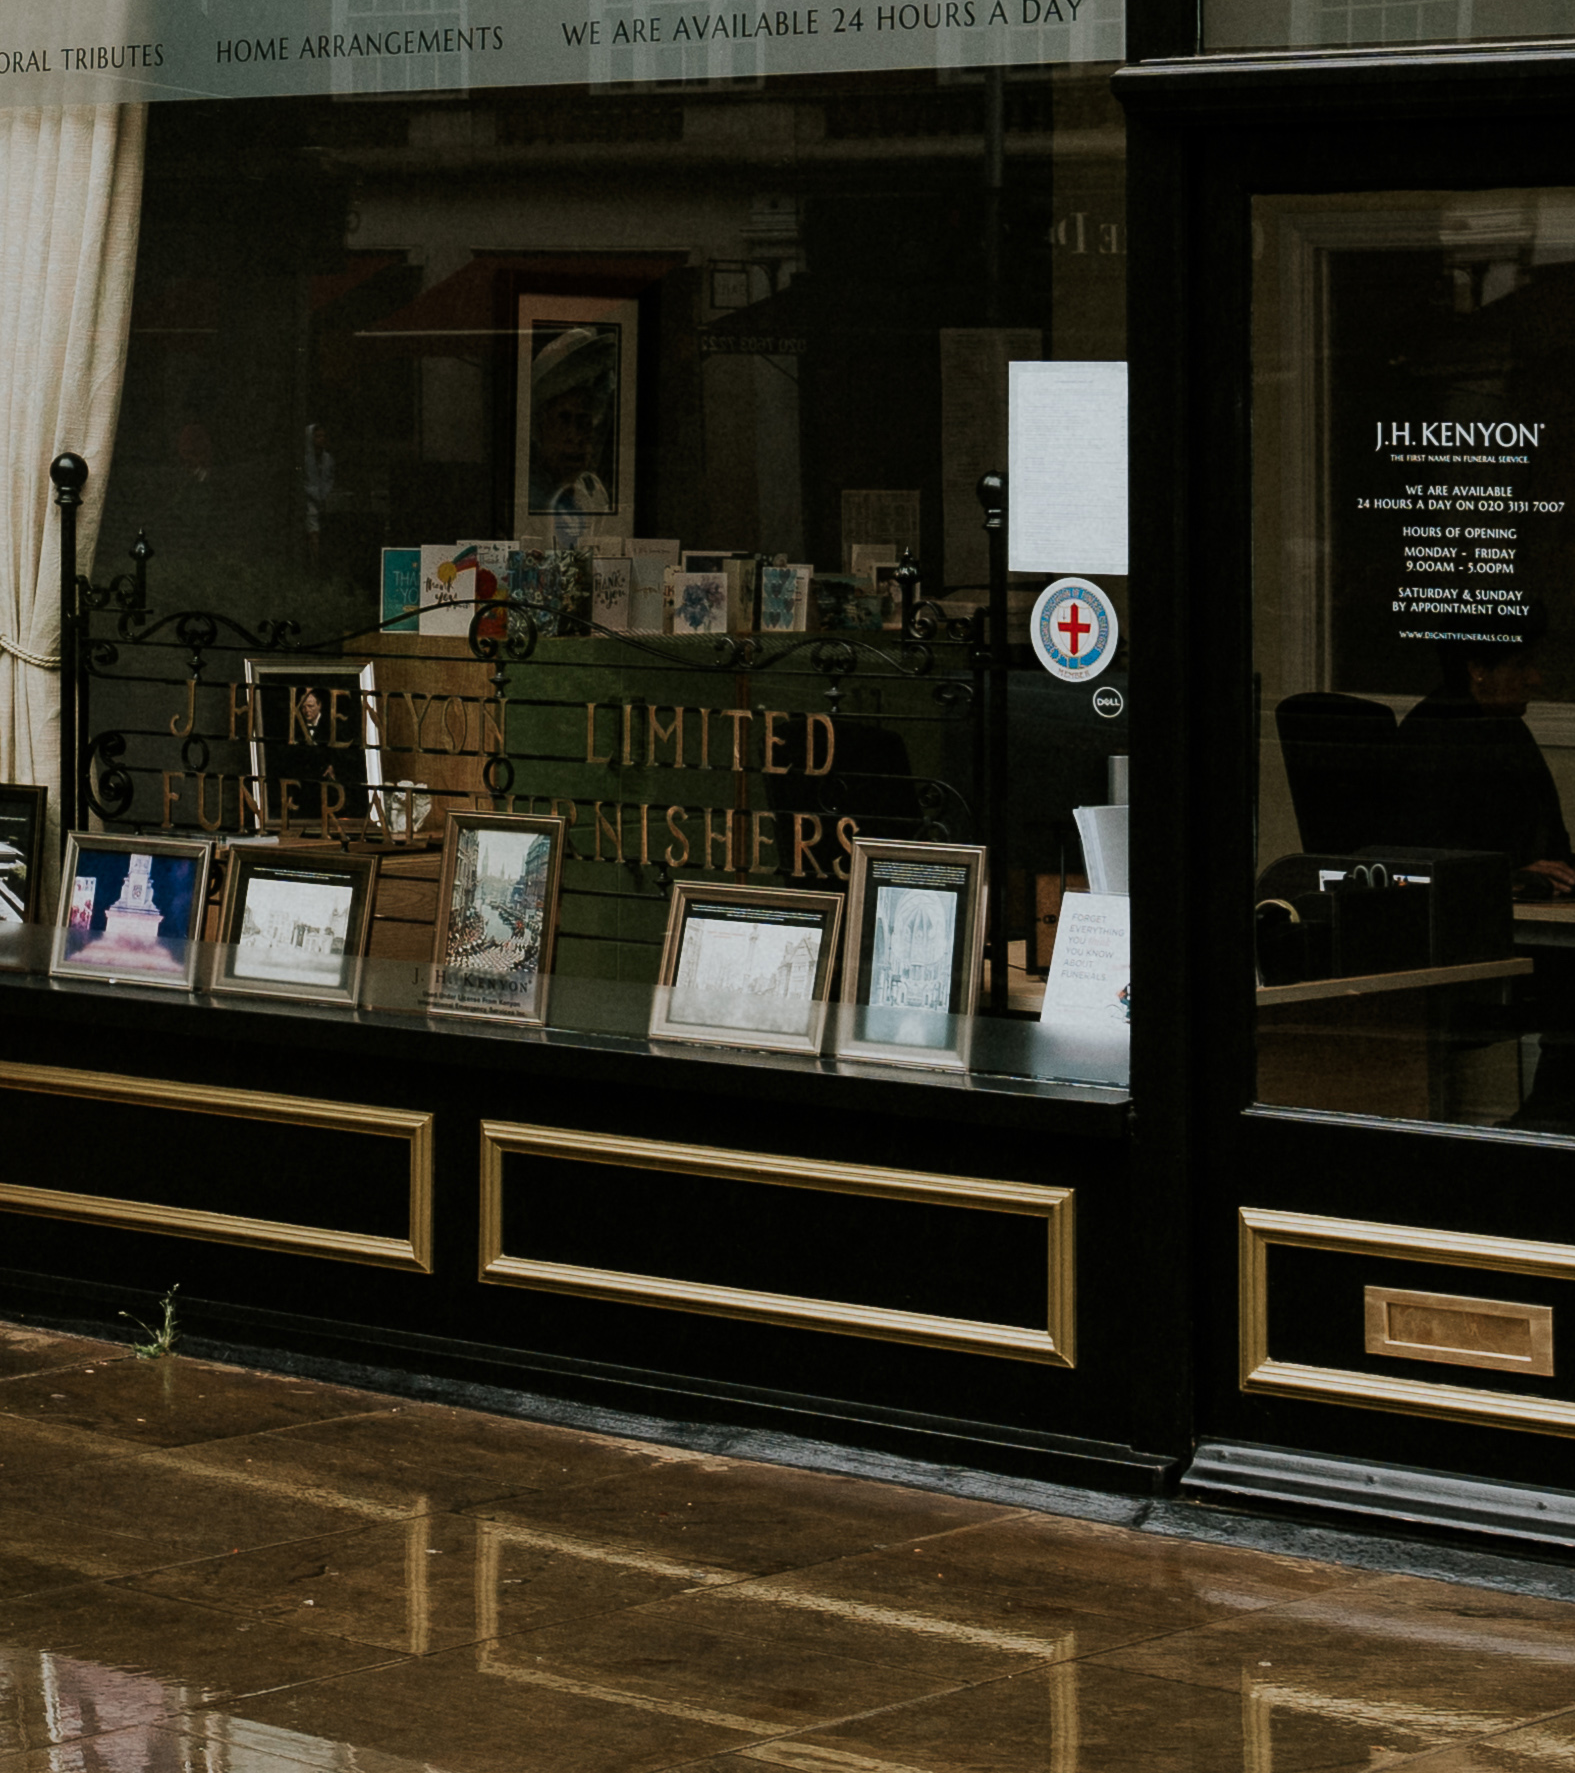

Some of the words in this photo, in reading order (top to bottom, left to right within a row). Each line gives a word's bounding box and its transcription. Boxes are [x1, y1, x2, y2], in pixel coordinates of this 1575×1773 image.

[561, 21, 605, 48] WE
[610, 17, 666, 46] ARE
[673, 7, 821, 42] AVAILABLE
[832, 6, 865, 35] 24
[875, 0, 977, 32] HOURS
[216, 35, 291, 65] HOME
[300, 26, 505, 60] ARRANGEMENTS
[61, 41, 166, 73] TRIBUTES
[1375, 421, 1416, 451] J.H.
[1422, 421, 1540, 447] KENYON
[1390, 454, 1404, 462] THE
[1406, 454, 1426, 463] FIRST
[1428, 455, 1450, 463] NAME
[1452, 455, 1461, 463] IN
[1463, 455, 1496, 464] FUNERAL
[1405, 485, 1423, 496] WE
[1427, 485, 1448, 496] ARE
[1452, 485, 1513, 498] AVAILABLE
[1357, 498, 1370, 509] 24
[1374, 498, 1413, 510] HOURS
[1416, 499, 1425, 510] A
[1428, 499, 1452, 511] DAY
[1456, 499, 1474, 511] ON
[1478, 501, 1504, 513] 020
[1508, 501, 1529, 514] 3131
[1533, 501, 1565, 514] 7007
[1402, 526, 1442, 538] HOURS
[1445, 527, 1461, 538] OF
[1464, 528, 1517, 540] OPENING
[1404, 547, 1458, 559] MONDAY
[1475, 548, 1516, 560] FRIDAY
[1405, 561, 1455, 573] 9.00AM
[1467, 562, 1515, 575] 5.00PM
[1398, 587, 1458, 600] SATURDAY
[1462, 589, 1474, 602] &
[1475, 589, 1523, 602] SUNDAY
[1392, 601, 1408, 612] BY
[1410, 602, 1494, 616] APPOINTMENT
[1497, 604, 1530, 617] ONLY
[1399, 630, 1523, 643] WWW.DIGNITYFUNERALS.CO.UK
[1058, 668, 1090, 678] MEMBER
[1097, 698, 1120, 706] DELL
[170, 678, 197, 738] J
[228, 683, 255, 741] H
[287, 687, 509, 756] KENYON
[585, 701, 837, 777] LIMITED
[162, 771, 429, 847] FUNERAL
[1072, 913, 1107, 923] FORGET
[1069, 925, 1125, 936] EVERYTHING
[1068, 936, 1086, 945] YOU
[1066, 947, 1083, 956] YOU
[1086, 949, 1114, 959] KNOW
[1063, 958, 1093, 968] ABOUT
[463, 972, 528, 994] KENYON
[499, 998, 521, 1008] Kenyon
[489, 1006, 514, 1016] Services
